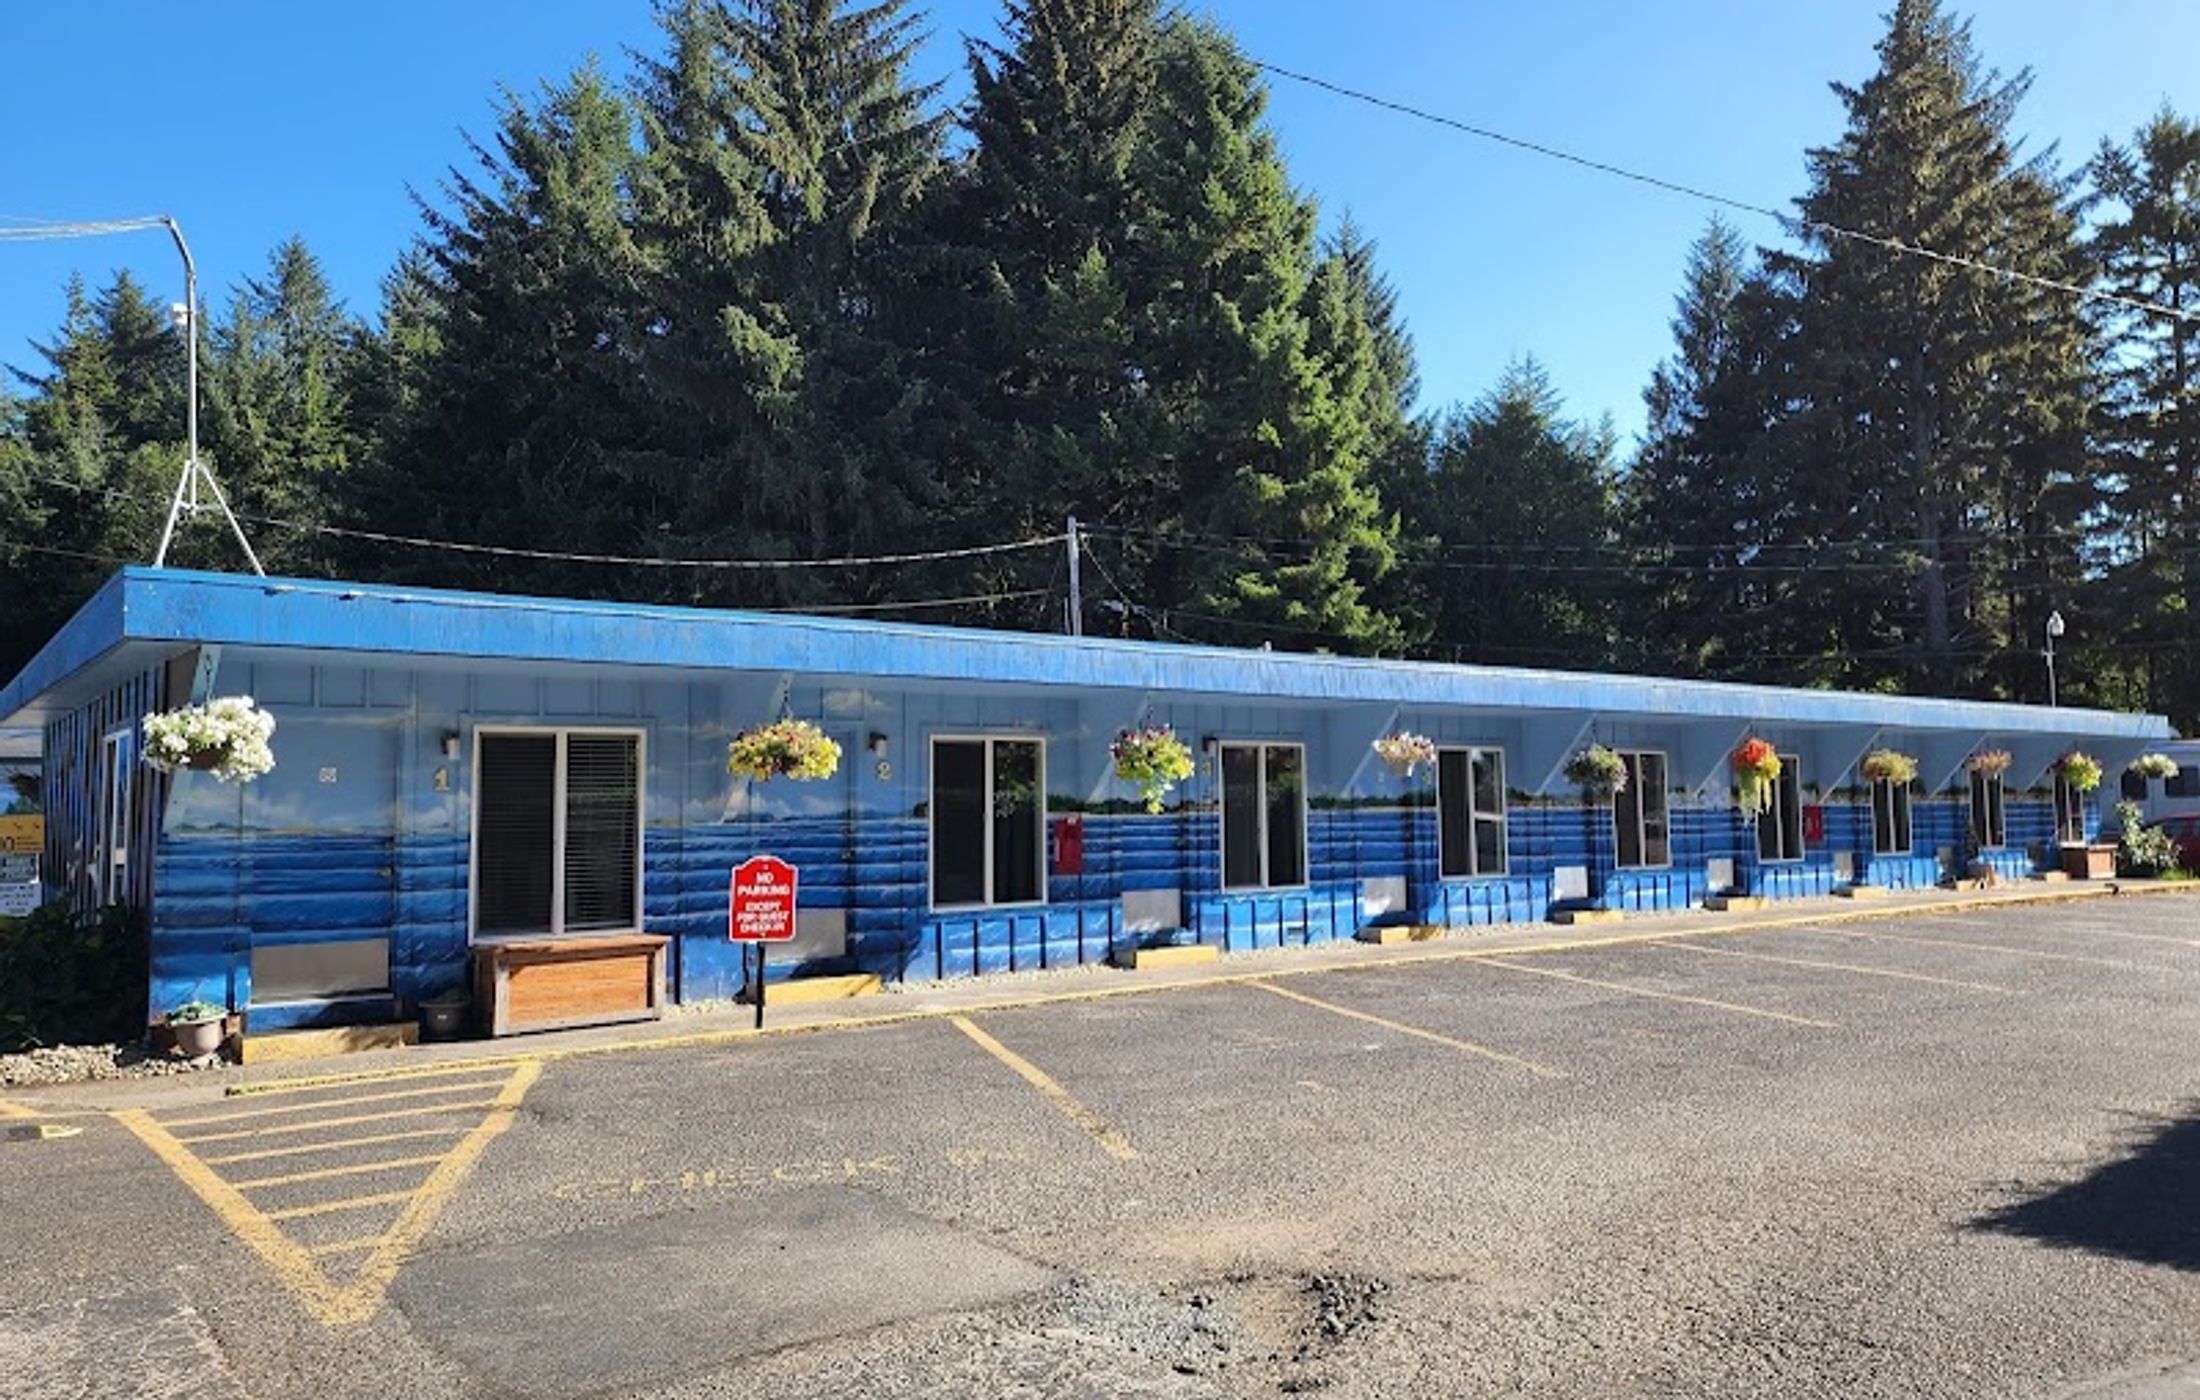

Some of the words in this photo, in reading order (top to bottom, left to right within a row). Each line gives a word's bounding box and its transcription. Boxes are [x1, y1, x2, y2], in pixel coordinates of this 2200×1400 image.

[434, 768, 450, 791] 1
[756, 872, 775, 884] NO
[737, 884, 791, 897] PARKING
[745, 901, 782, 912] EXCEPT
